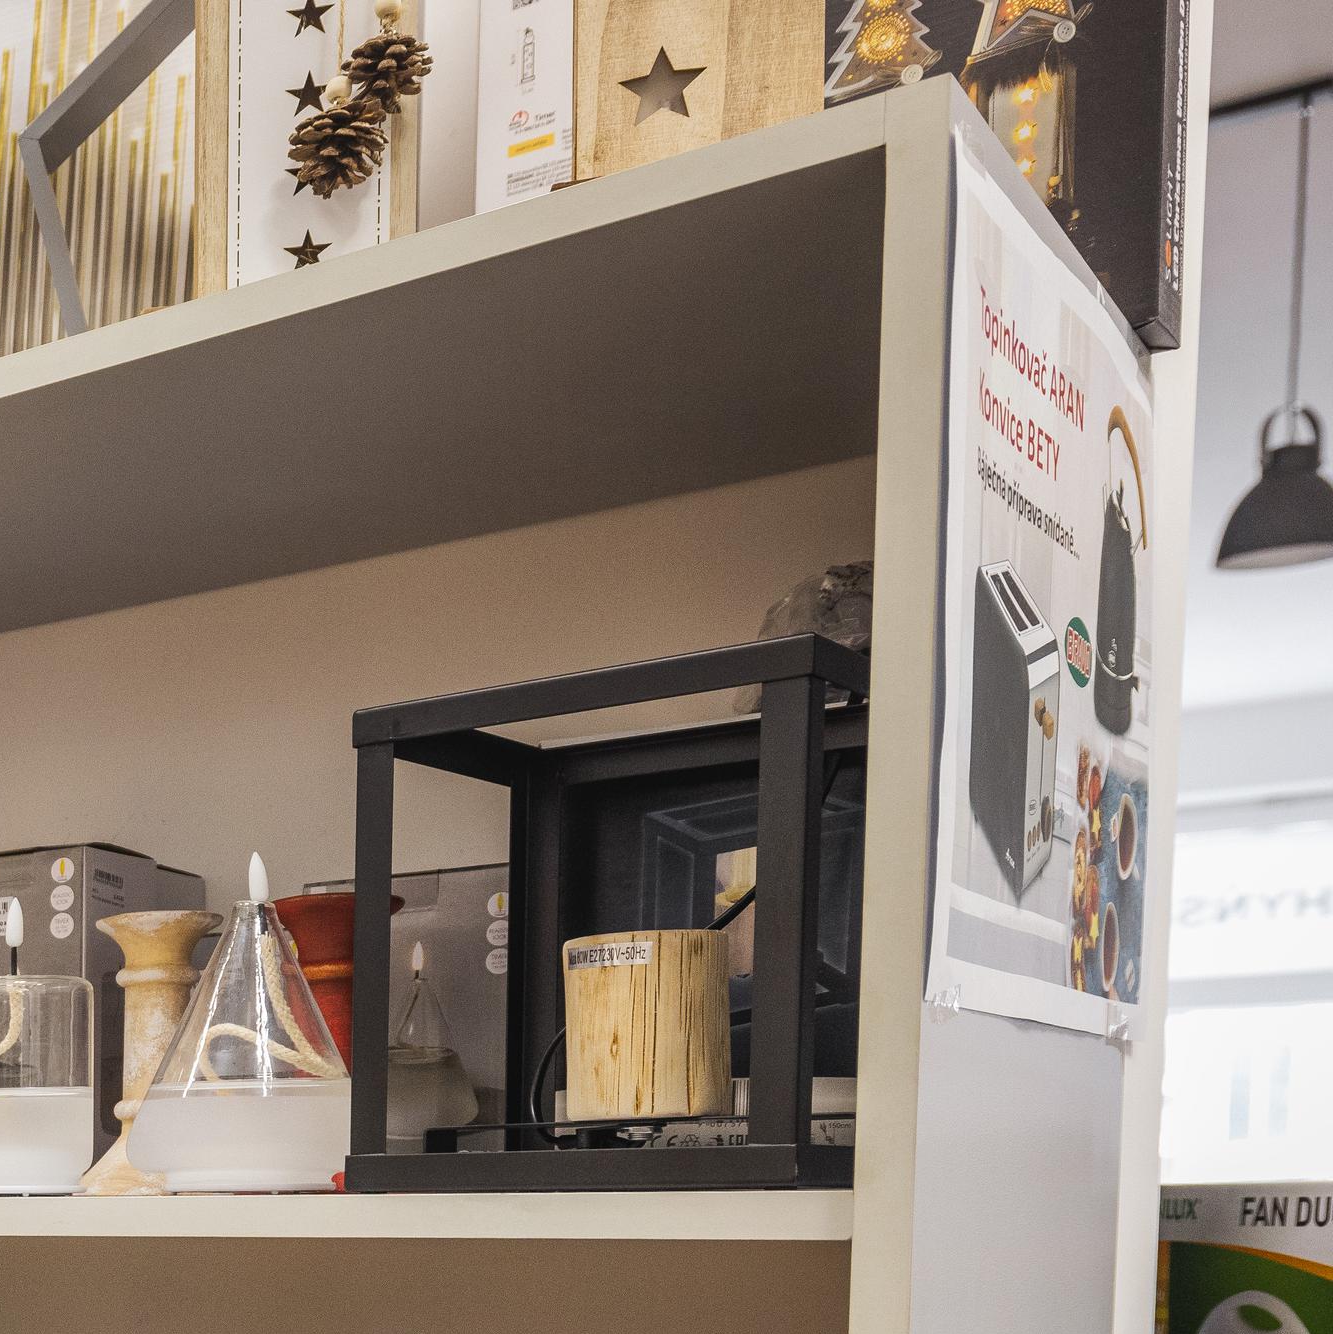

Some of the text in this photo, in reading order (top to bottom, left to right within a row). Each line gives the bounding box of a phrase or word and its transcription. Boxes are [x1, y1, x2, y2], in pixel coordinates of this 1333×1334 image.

[980, 284, 1085, 433] Topinkovač ARAN
[978, 366, 1061, 482] Konvice BETY
[976, 445, 1007, 500] Báječná
[1007, 478, 1043, 530] příprava
[1240, 1196, 1333, 1228] FAN DU
